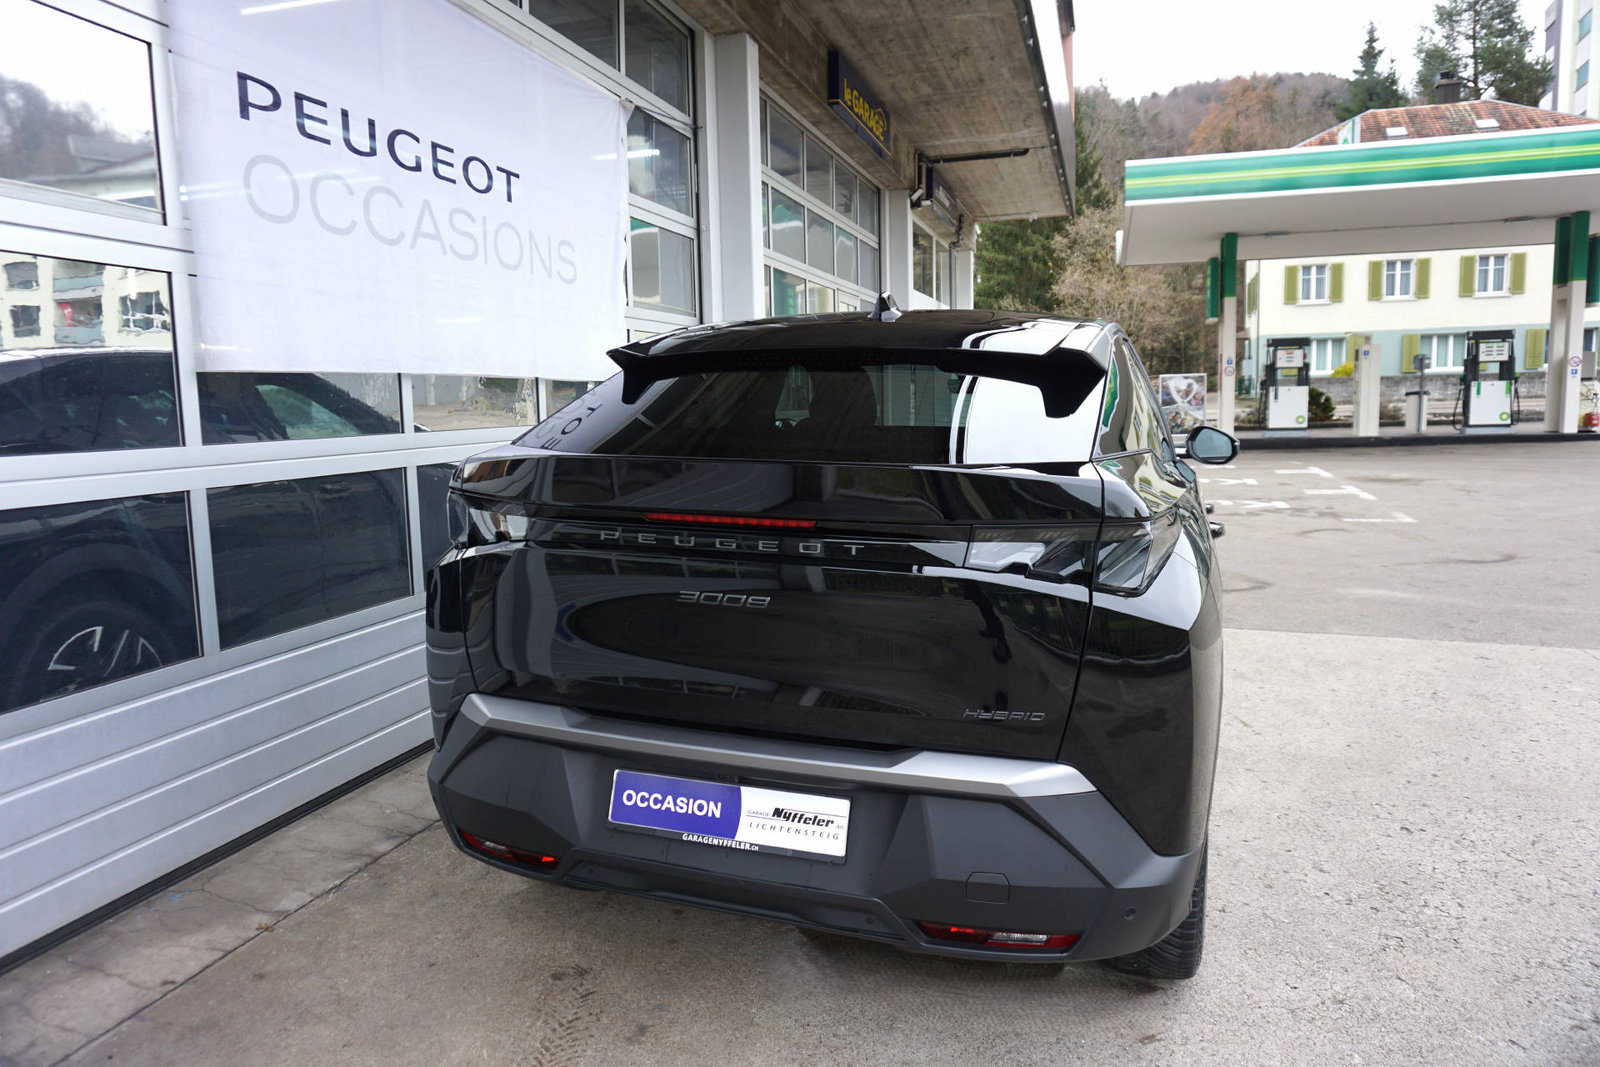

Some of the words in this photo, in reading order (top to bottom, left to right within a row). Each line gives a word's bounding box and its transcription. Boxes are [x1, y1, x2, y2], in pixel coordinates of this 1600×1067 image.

[852, 90, 885, 142] GARAGE
[237, 71, 520, 203] PEUGEOT
[242, 154, 578, 285] OCCASIONS
[600, 530, 865, 556] PEUGEOT
[676, 590, 771, 609] 3008
[963, 708, 1046, 721] HYBRID
[622, 789, 722, 819] OCCASION
[747, 809, 770, 817] GARAGE
[771, 807, 835, 828] Nyffeler
[749, 822, 840, 840] LICHTENSTEIG
